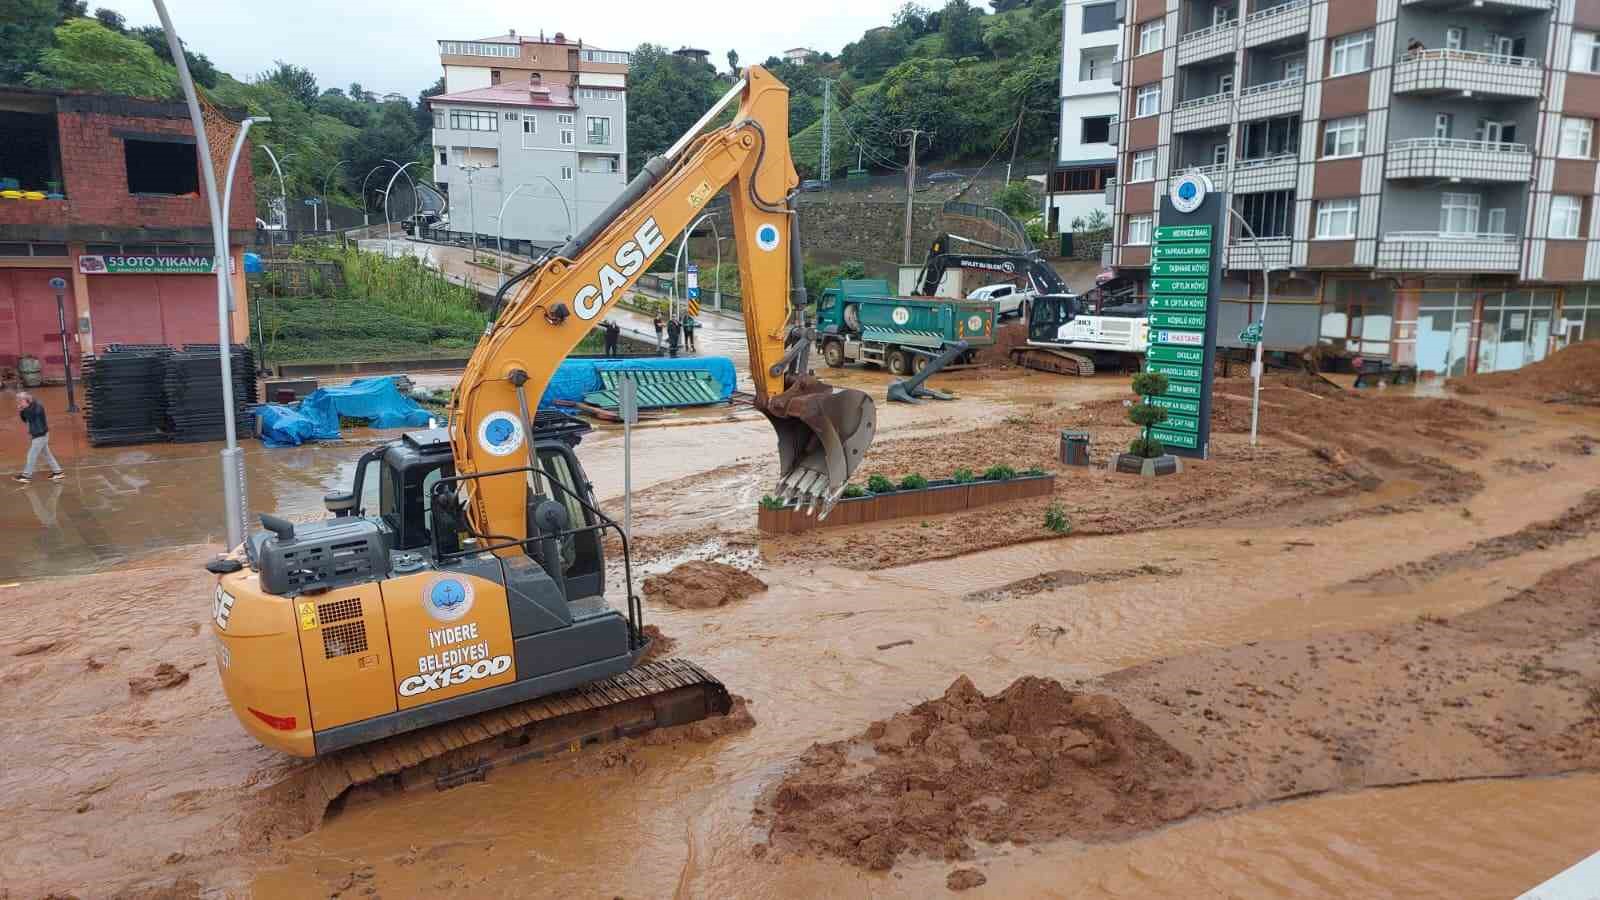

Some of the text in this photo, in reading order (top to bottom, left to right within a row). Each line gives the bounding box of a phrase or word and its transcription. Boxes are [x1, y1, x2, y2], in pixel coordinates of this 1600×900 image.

[109, 257, 209, 266] 53 OTO YIKAMA
[573, 216, 665, 320] CASE
[428, 622, 479, 649] İYİDERE
[418, 639, 489, 673] BELEDİYESİ
[398, 655, 512, 697] CX130D
